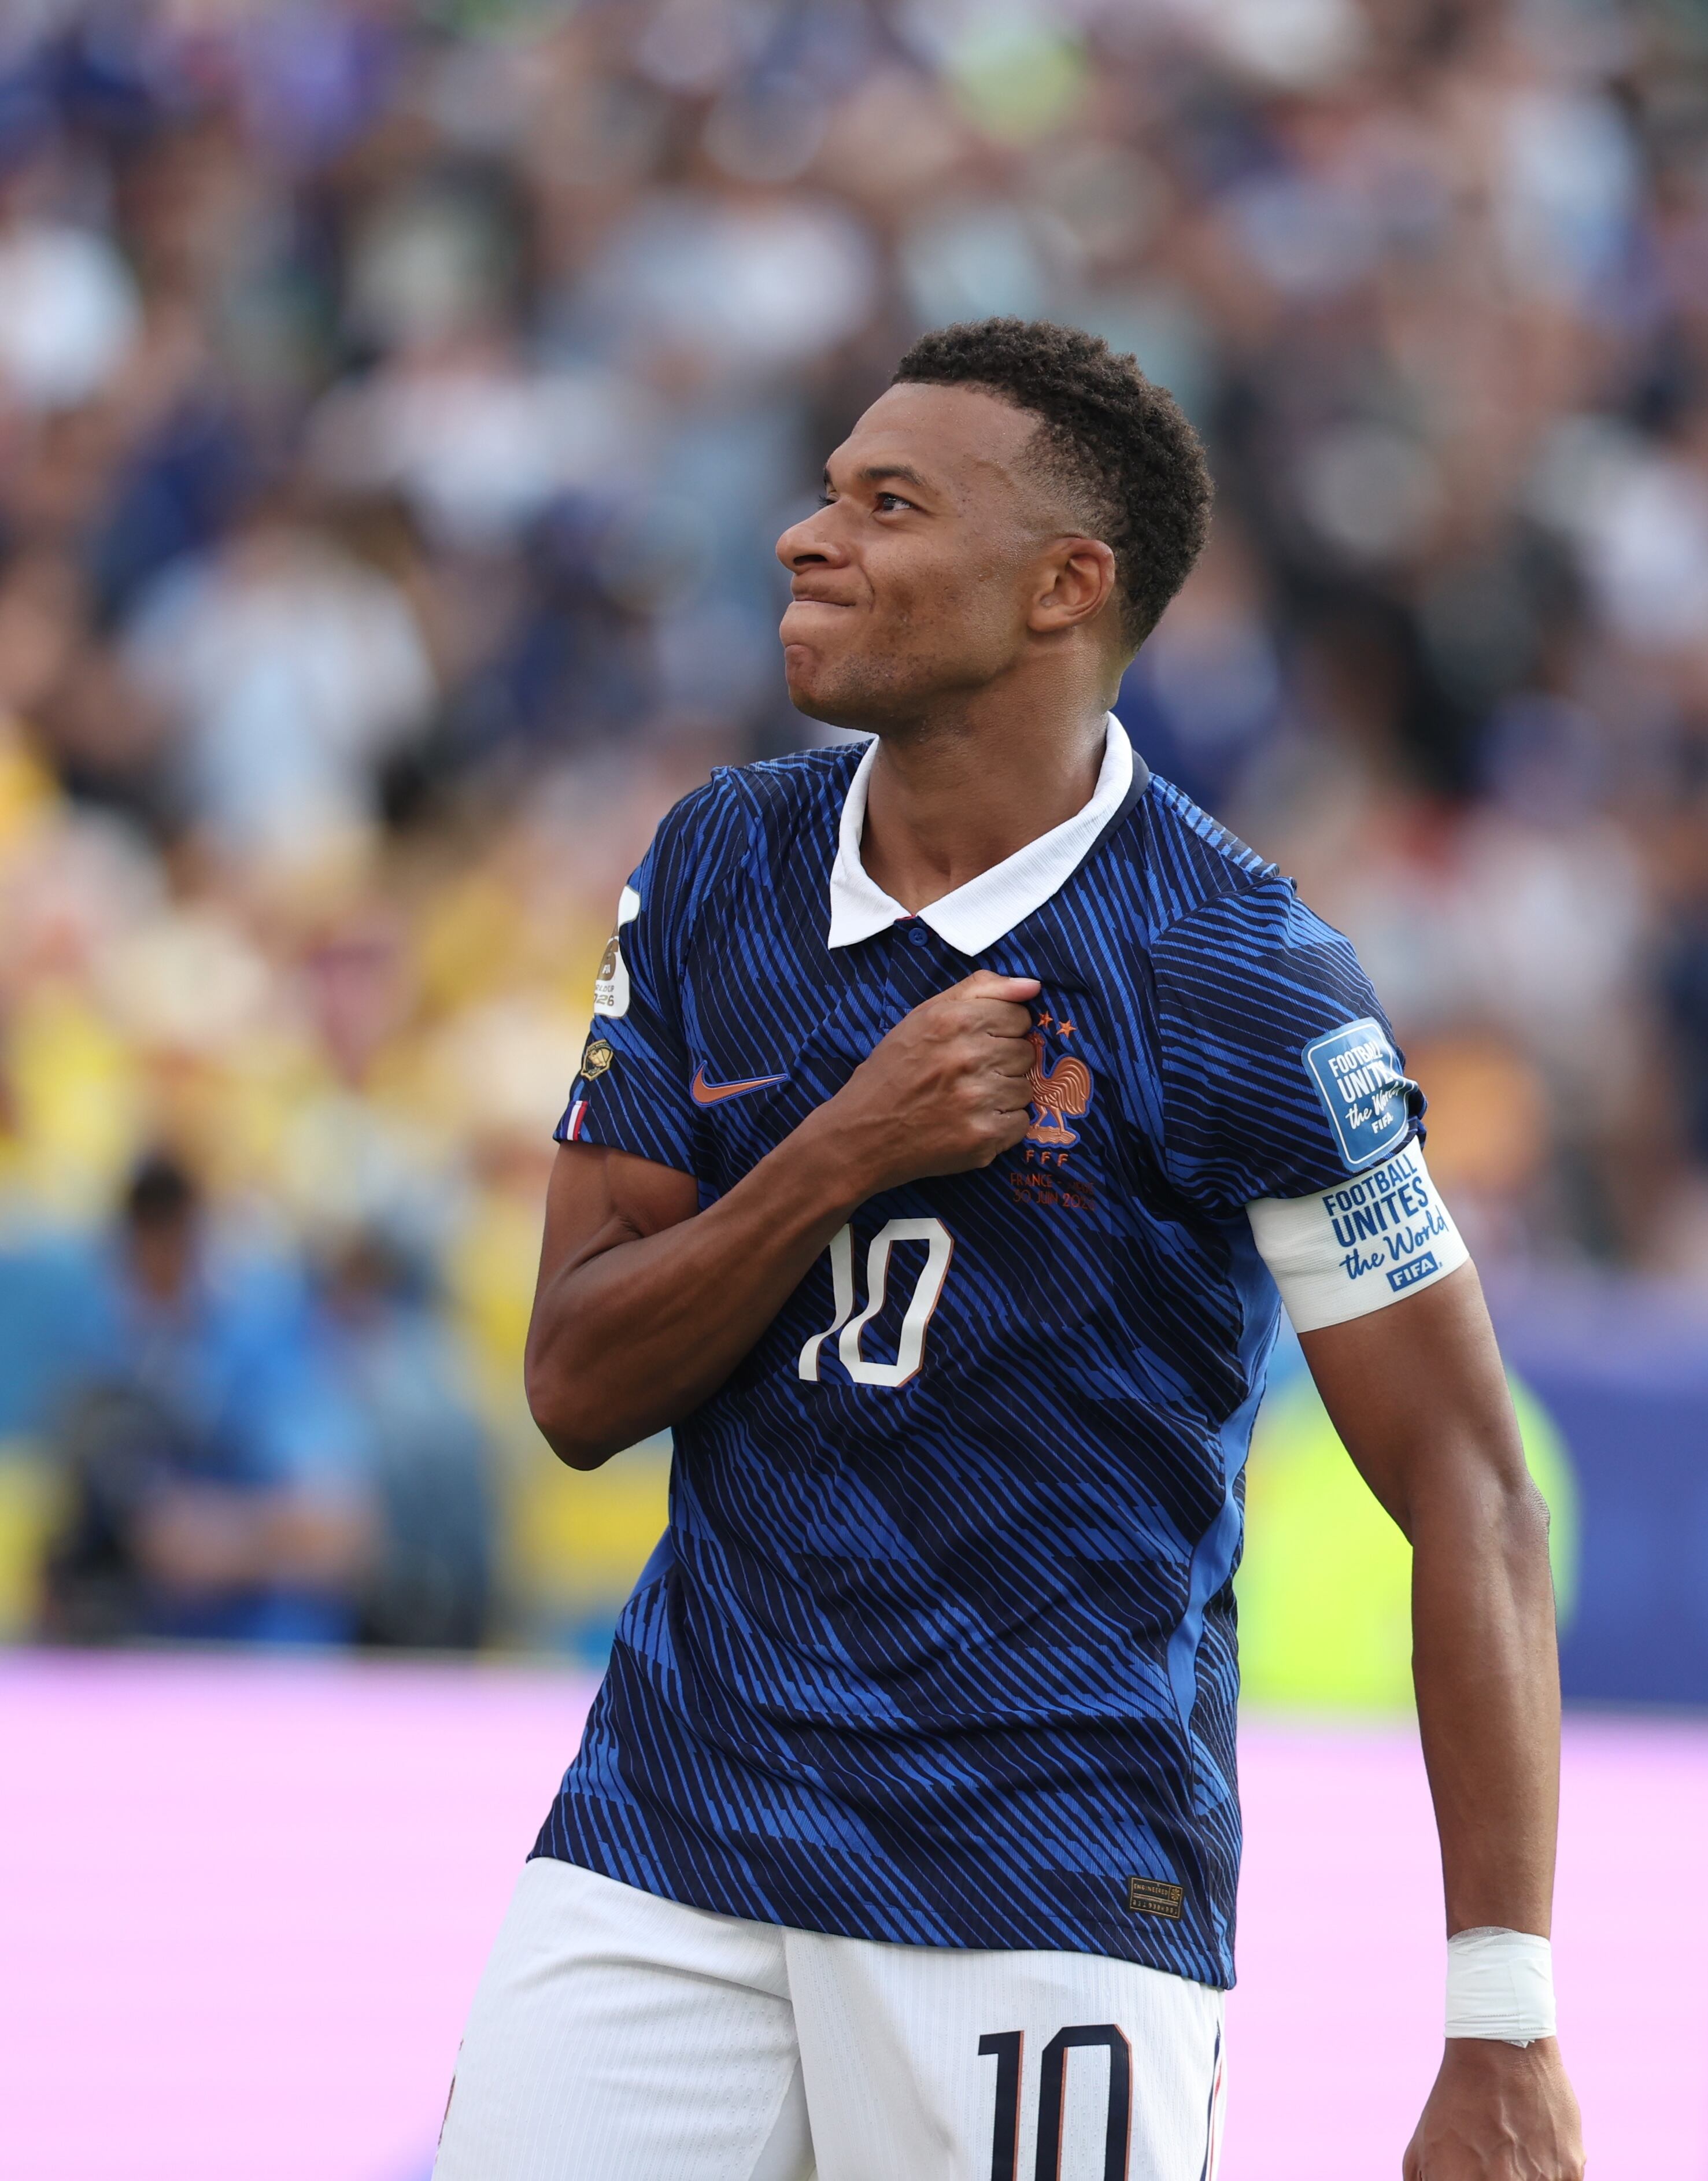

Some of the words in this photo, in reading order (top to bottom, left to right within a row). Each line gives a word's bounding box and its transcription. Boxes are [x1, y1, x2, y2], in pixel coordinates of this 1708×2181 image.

[1328, 1041, 1384, 1078] FOOTBALL
[1336, 1060, 1397, 1104] UNITE
[1345, 1103, 1372, 1130] the
[1371, 1112, 1394, 1134] FIFA
[1010, 1173, 1053, 1188] FRANCE
[1013, 1189, 1032, 1203] 30
[1036, 1190, 1058, 1204] JUIN
[1322, 1154, 1418, 1217] FOOTBALL
[1332, 1176, 1429, 1248] UNITES
[1339, 1248, 1385, 1280] the
[1382, 1204, 1450, 1261] World
[1392, 1258, 1434, 1287] FIFA
[798, 1217, 955, 1388] 10
[978, 2024, 1132, 2181] 10
